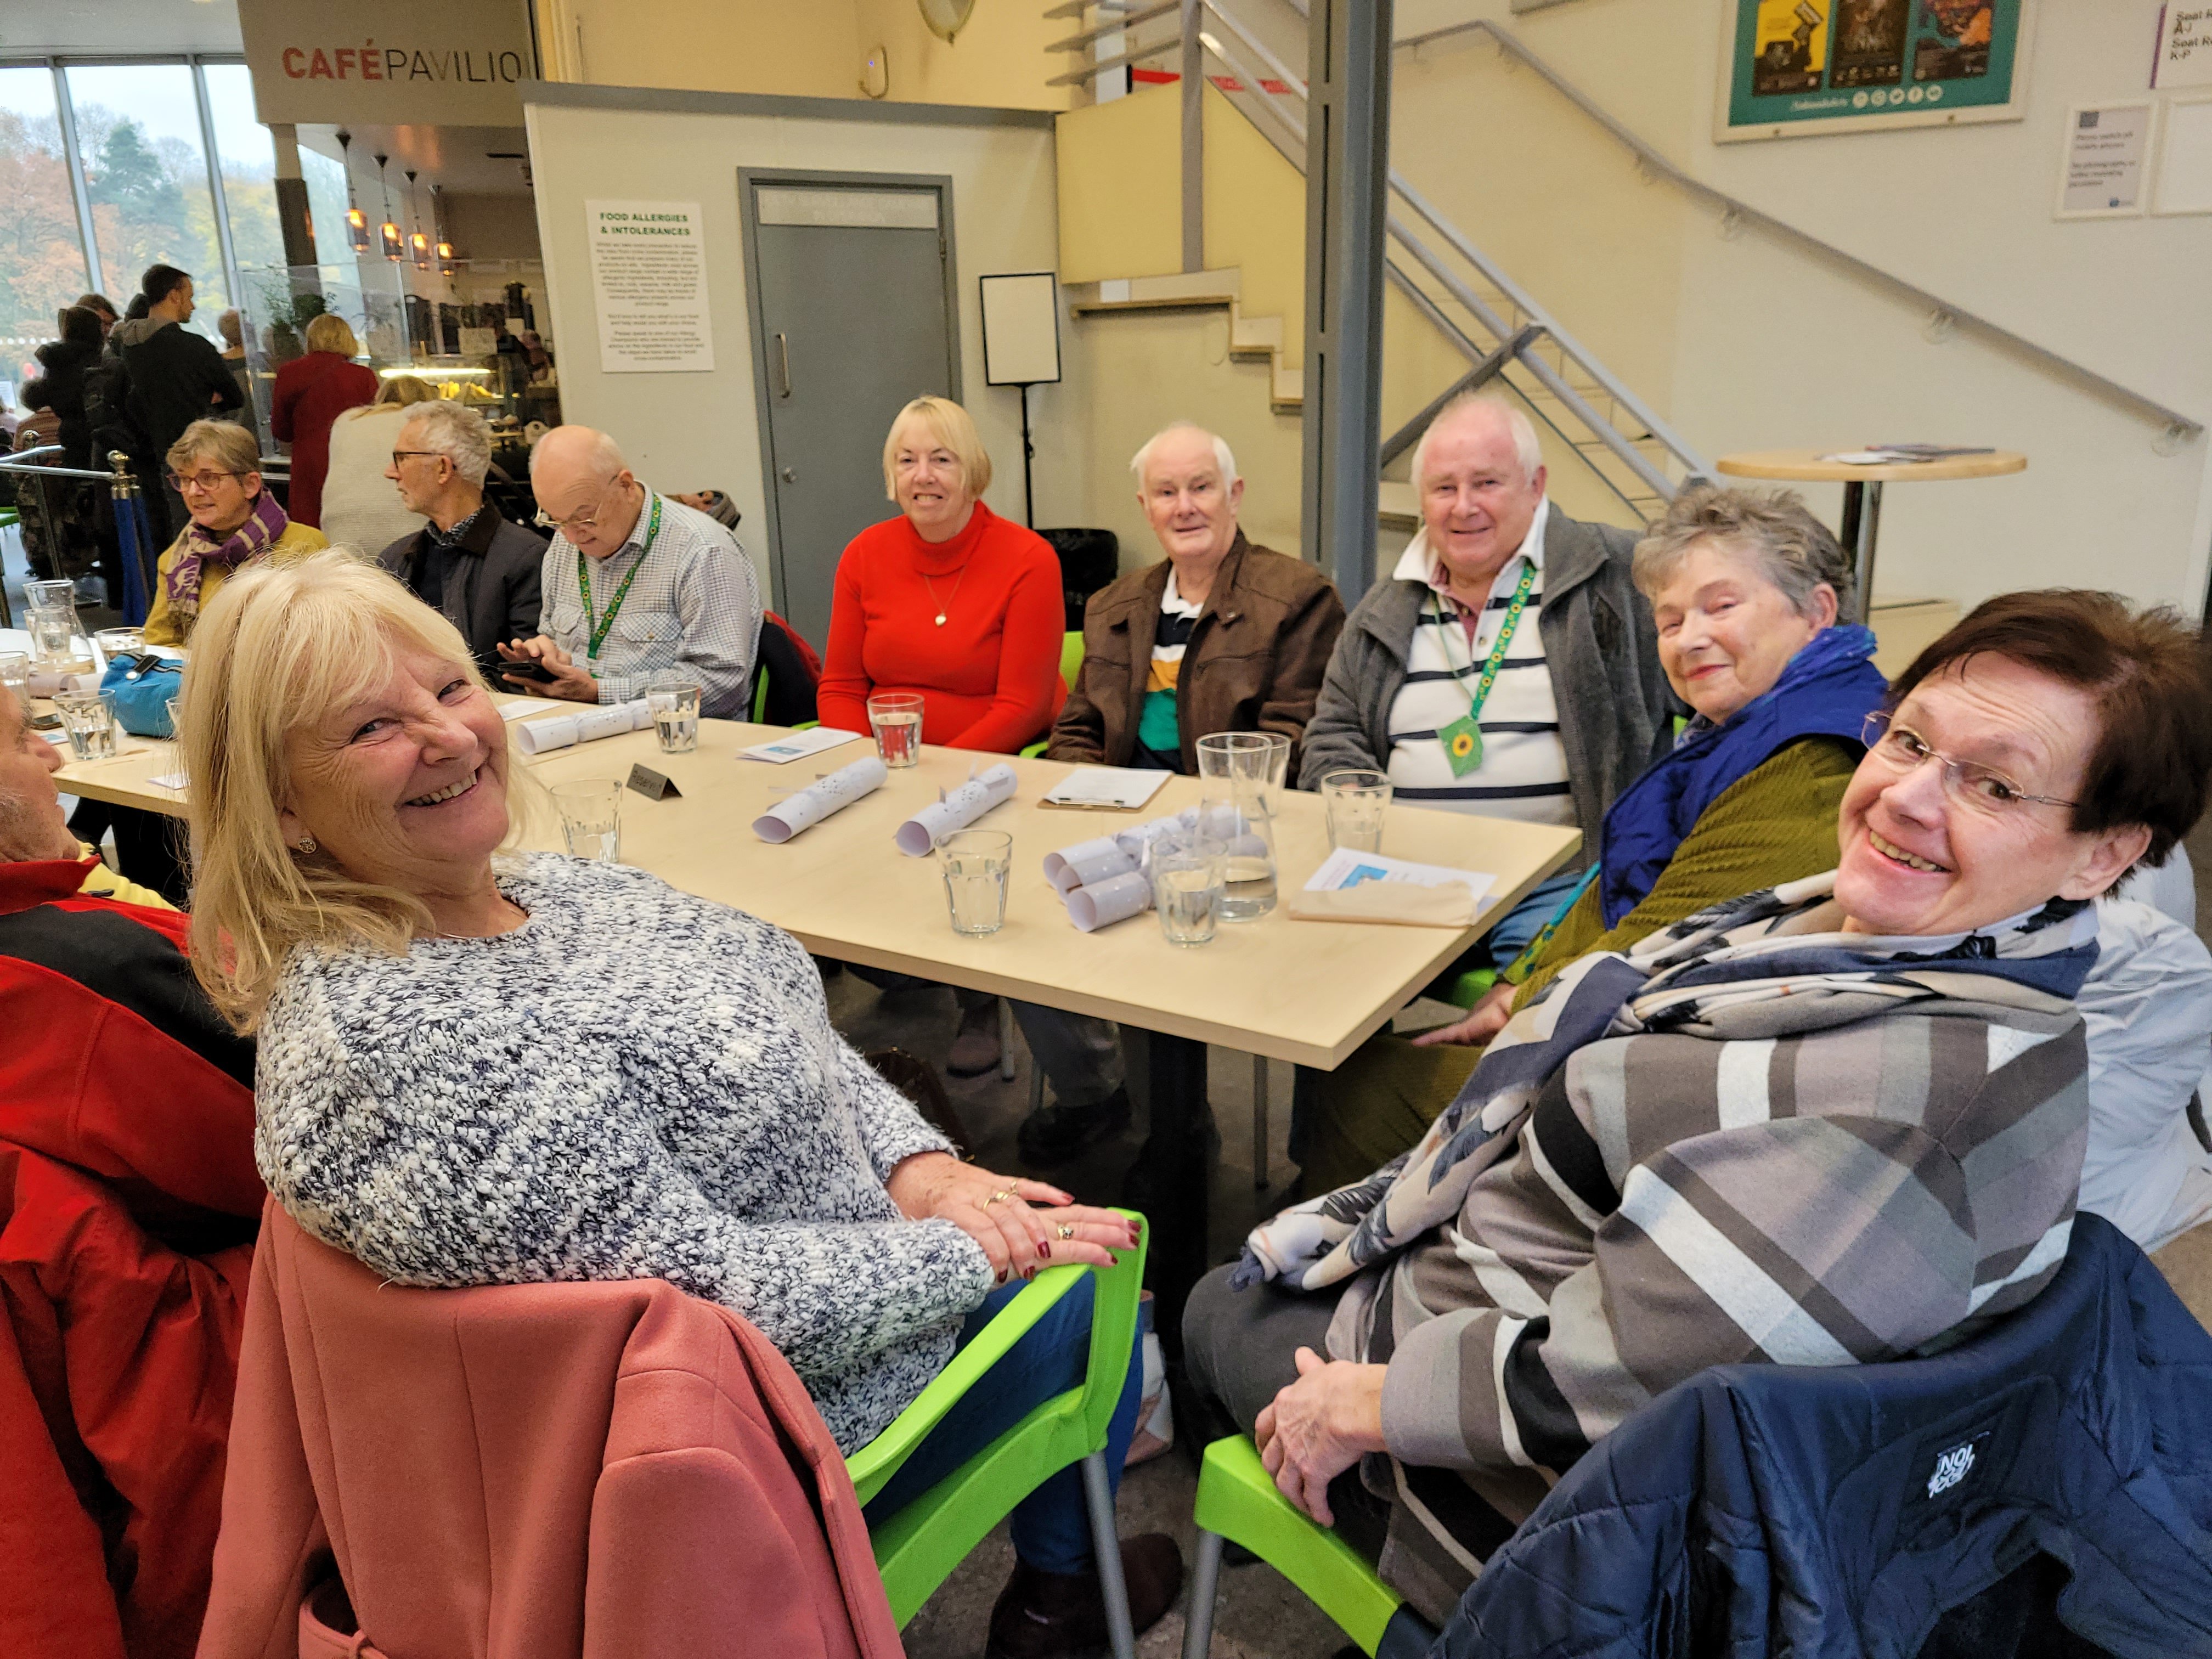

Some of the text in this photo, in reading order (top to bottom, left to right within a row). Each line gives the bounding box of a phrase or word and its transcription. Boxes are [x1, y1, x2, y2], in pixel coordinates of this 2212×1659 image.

[386, 49, 531, 82] PAVILIO
[600, 212, 689, 222] FOOD ALLERGIES
[600, 226, 691, 235] & INTOLERANCES
